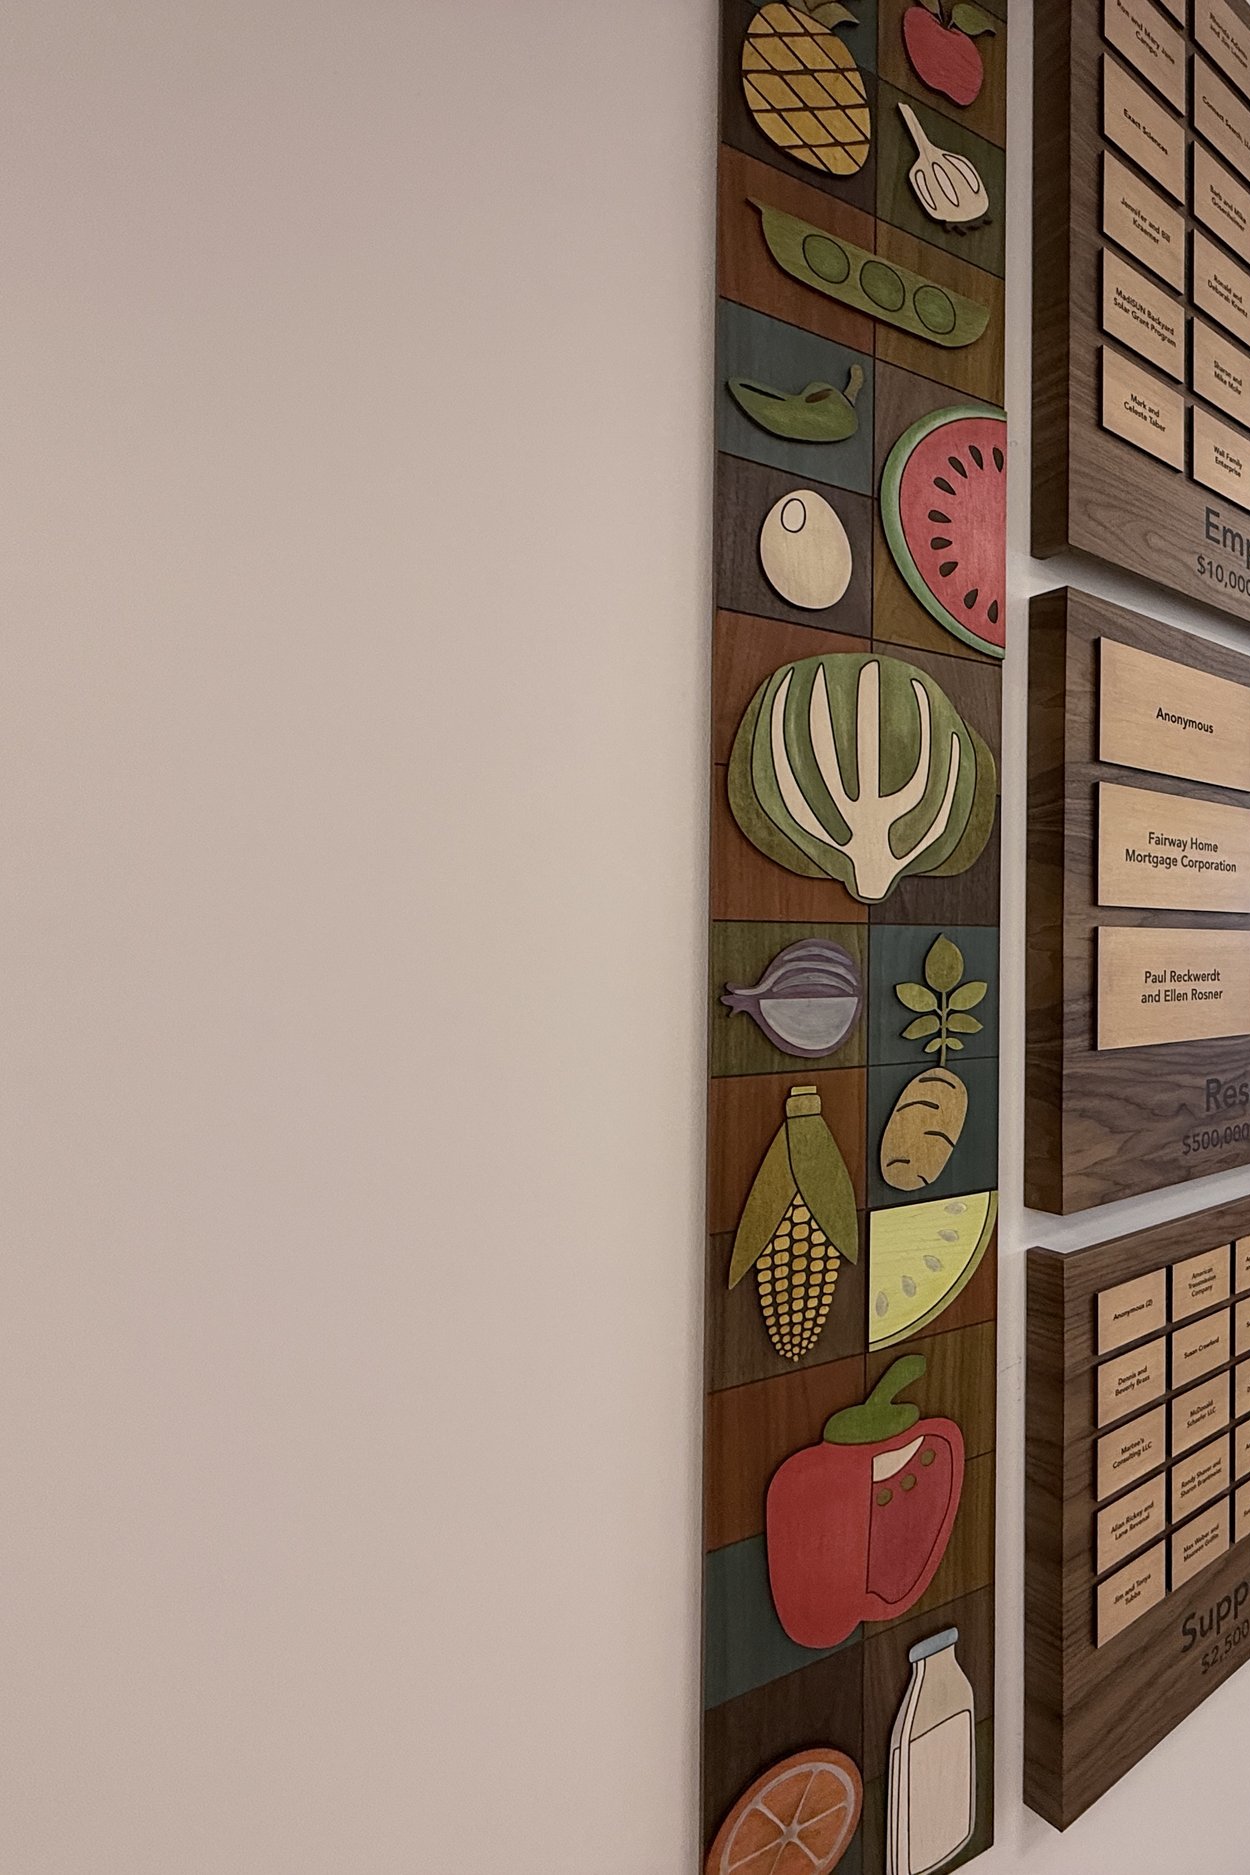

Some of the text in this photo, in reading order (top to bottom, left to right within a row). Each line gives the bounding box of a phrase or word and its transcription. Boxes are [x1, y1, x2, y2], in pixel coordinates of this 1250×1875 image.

[1130, 15, 1143, 31] and
[1143, 27, 1160, 50] Mary
[1161, 47, 1175, 65] Jane
[1135, 30, 1158, 58] Campo
[1209, 23, 1221, 39] and
[1201, 95, 1224, 123] Connect
[1123, 107, 1168, 155] Exact Sciences
[1120, 197, 1171, 243] Jennifer and Bill
[1222, 199, 1234, 212] and
[1233, 207, 1247, 225] Mike
[1132, 217, 1160, 244] Kraemer
[1207, 279, 1248, 318] Deborah Krantz
[1213, 273, 1243, 304] Ronald and
[1113, 296, 1177, 348] Solar Grant Program
[1115, 287, 1174, 336] MadiSUN Backyard
[1213, 359, 1243, 387] Sharon and
[1213, 370, 1242, 395] Mike Mohr
[1123, 400, 1166, 432] Celeste Taber
[1130, 393, 1160, 418] Mark and
[1213, 445, 1243, 470] Wall Family
[1214, 455, 1241, 478] Enterprise
[1156, 707, 1214, 734] Anonymous
[1148, 831, 1219, 853] Fairway Home
[1125, 848, 1237, 872] Mortgage Corporation
[1144, 968, 1220, 984] Paul Reckwerdt
[1140, 988, 1223, 1004] and Ellen Rosner
[1182, 1122, 1250, 1156] $500,000
[1187, 1274, 1217, 1289] Transmission
[1191, 1267, 1213, 1280] American
[1190, 1284, 1213, 1298] Company
[1112, 1298, 1153, 1321] Anonymous (2)
[1183, 1336, 1220, 1359] Susan Crawford
[1114, 1374, 1150, 1397] Beverly Brass
[1117, 1365, 1148, 1386] Dennis and
[1189, 1399, 1214, 1418] McDonald
[1206, 1405, 1216, 1417] LLC
[1112, 1440, 1152, 1469] Consulting LLC
[1180, 1475, 1196, 1489] Randy
[1211, 1457, 1222, 1469] and
[1179, 1483, 1197, 1498] Sharon
[1110, 1500, 1154, 1534] Allan Rickey and
[1182, 1523, 1220, 1554] Max Weber and
[1113, 1573, 1152, 1605] Jim and Tonya
[1124, 1590, 1141, 1605] Tubbs
[1201, 1619, 1250, 1675] $2,500
